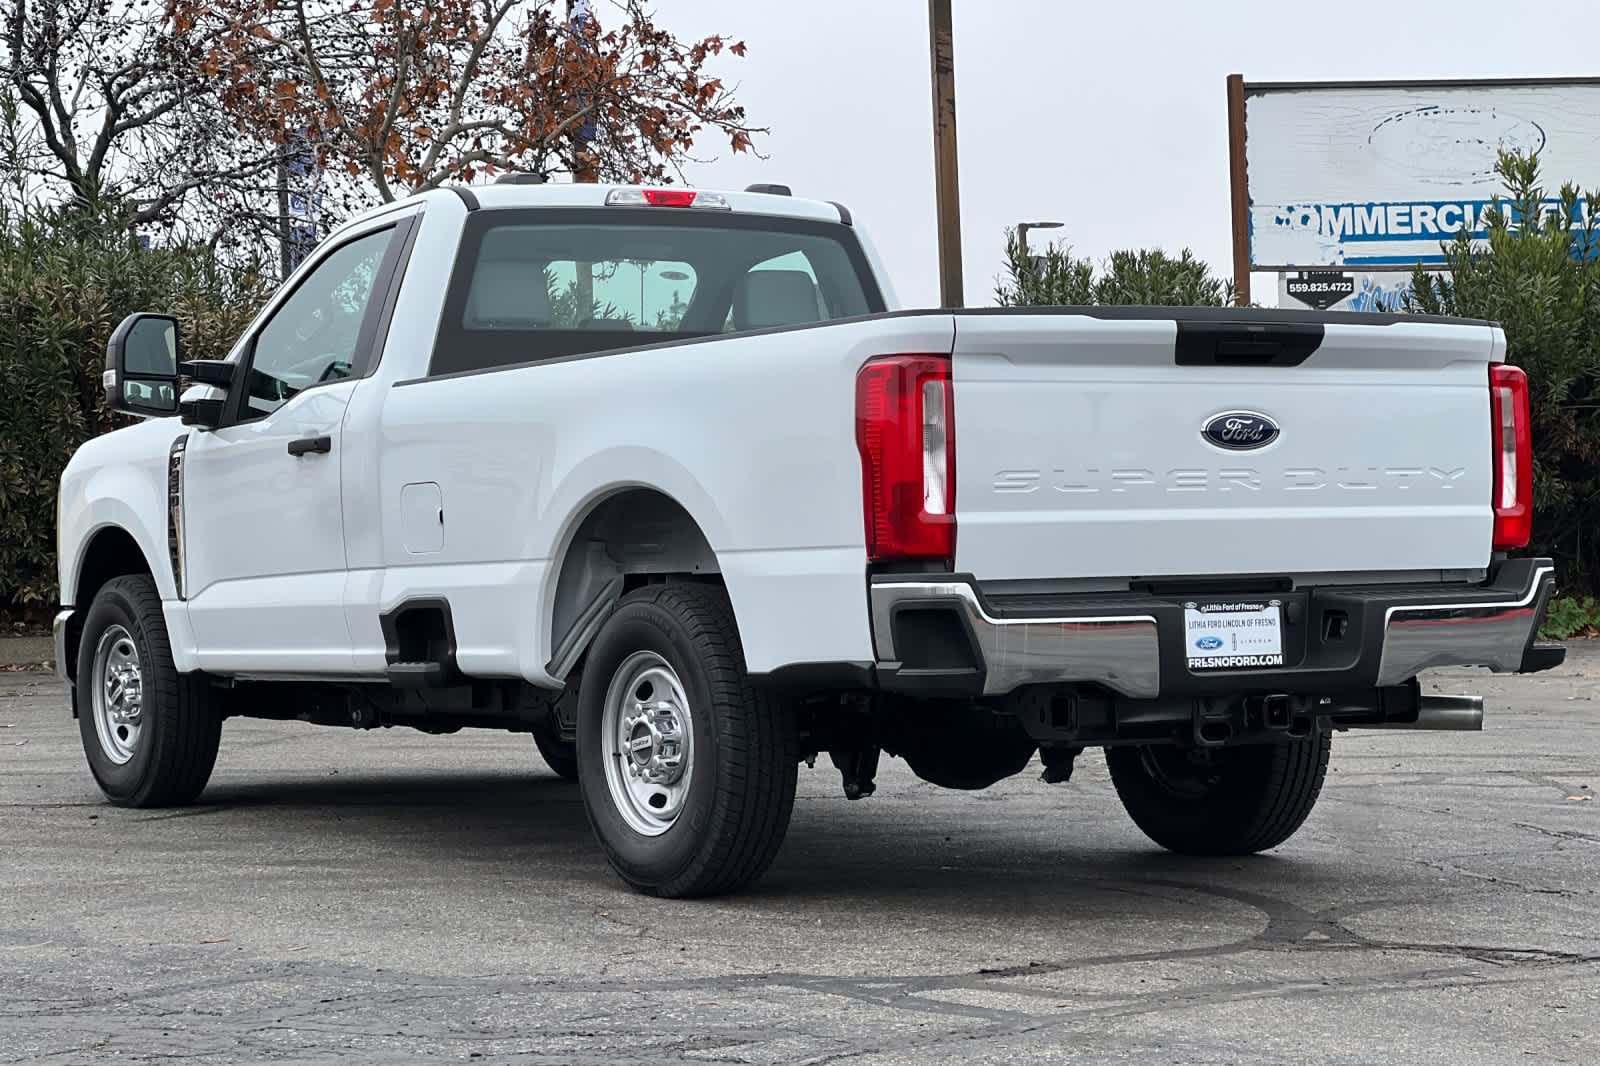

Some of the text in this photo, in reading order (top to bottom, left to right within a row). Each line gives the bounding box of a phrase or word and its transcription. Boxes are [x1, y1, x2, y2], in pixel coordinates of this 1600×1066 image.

[1289, 282, 1352, 293] 559.825.4722
[992, 467, 1465, 493] SUPER DUTY
[1206, 603, 1222, 611] Lithia
[1222, 603, 1234, 611] Ford
[1241, 602, 1259, 610] Fresno
[1188, 618, 1276, 630] LITHIA FORD LINCOLN OF FRESNO
[1188, 655, 1283, 669] FRESNOFORD.COM
